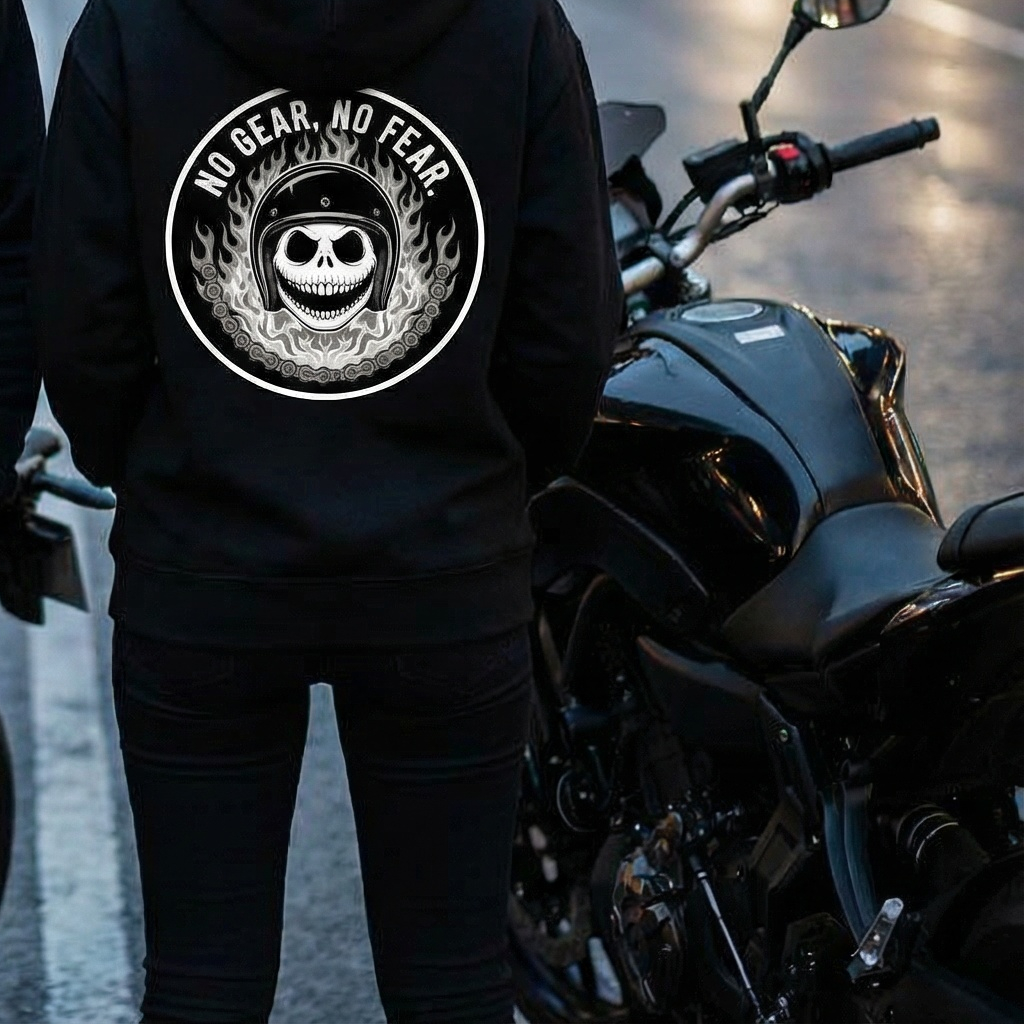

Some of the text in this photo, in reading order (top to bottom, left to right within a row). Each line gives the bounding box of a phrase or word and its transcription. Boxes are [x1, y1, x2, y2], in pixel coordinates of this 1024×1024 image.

[194, 100, 450, 197] NO GEAR, NO FEAR.
